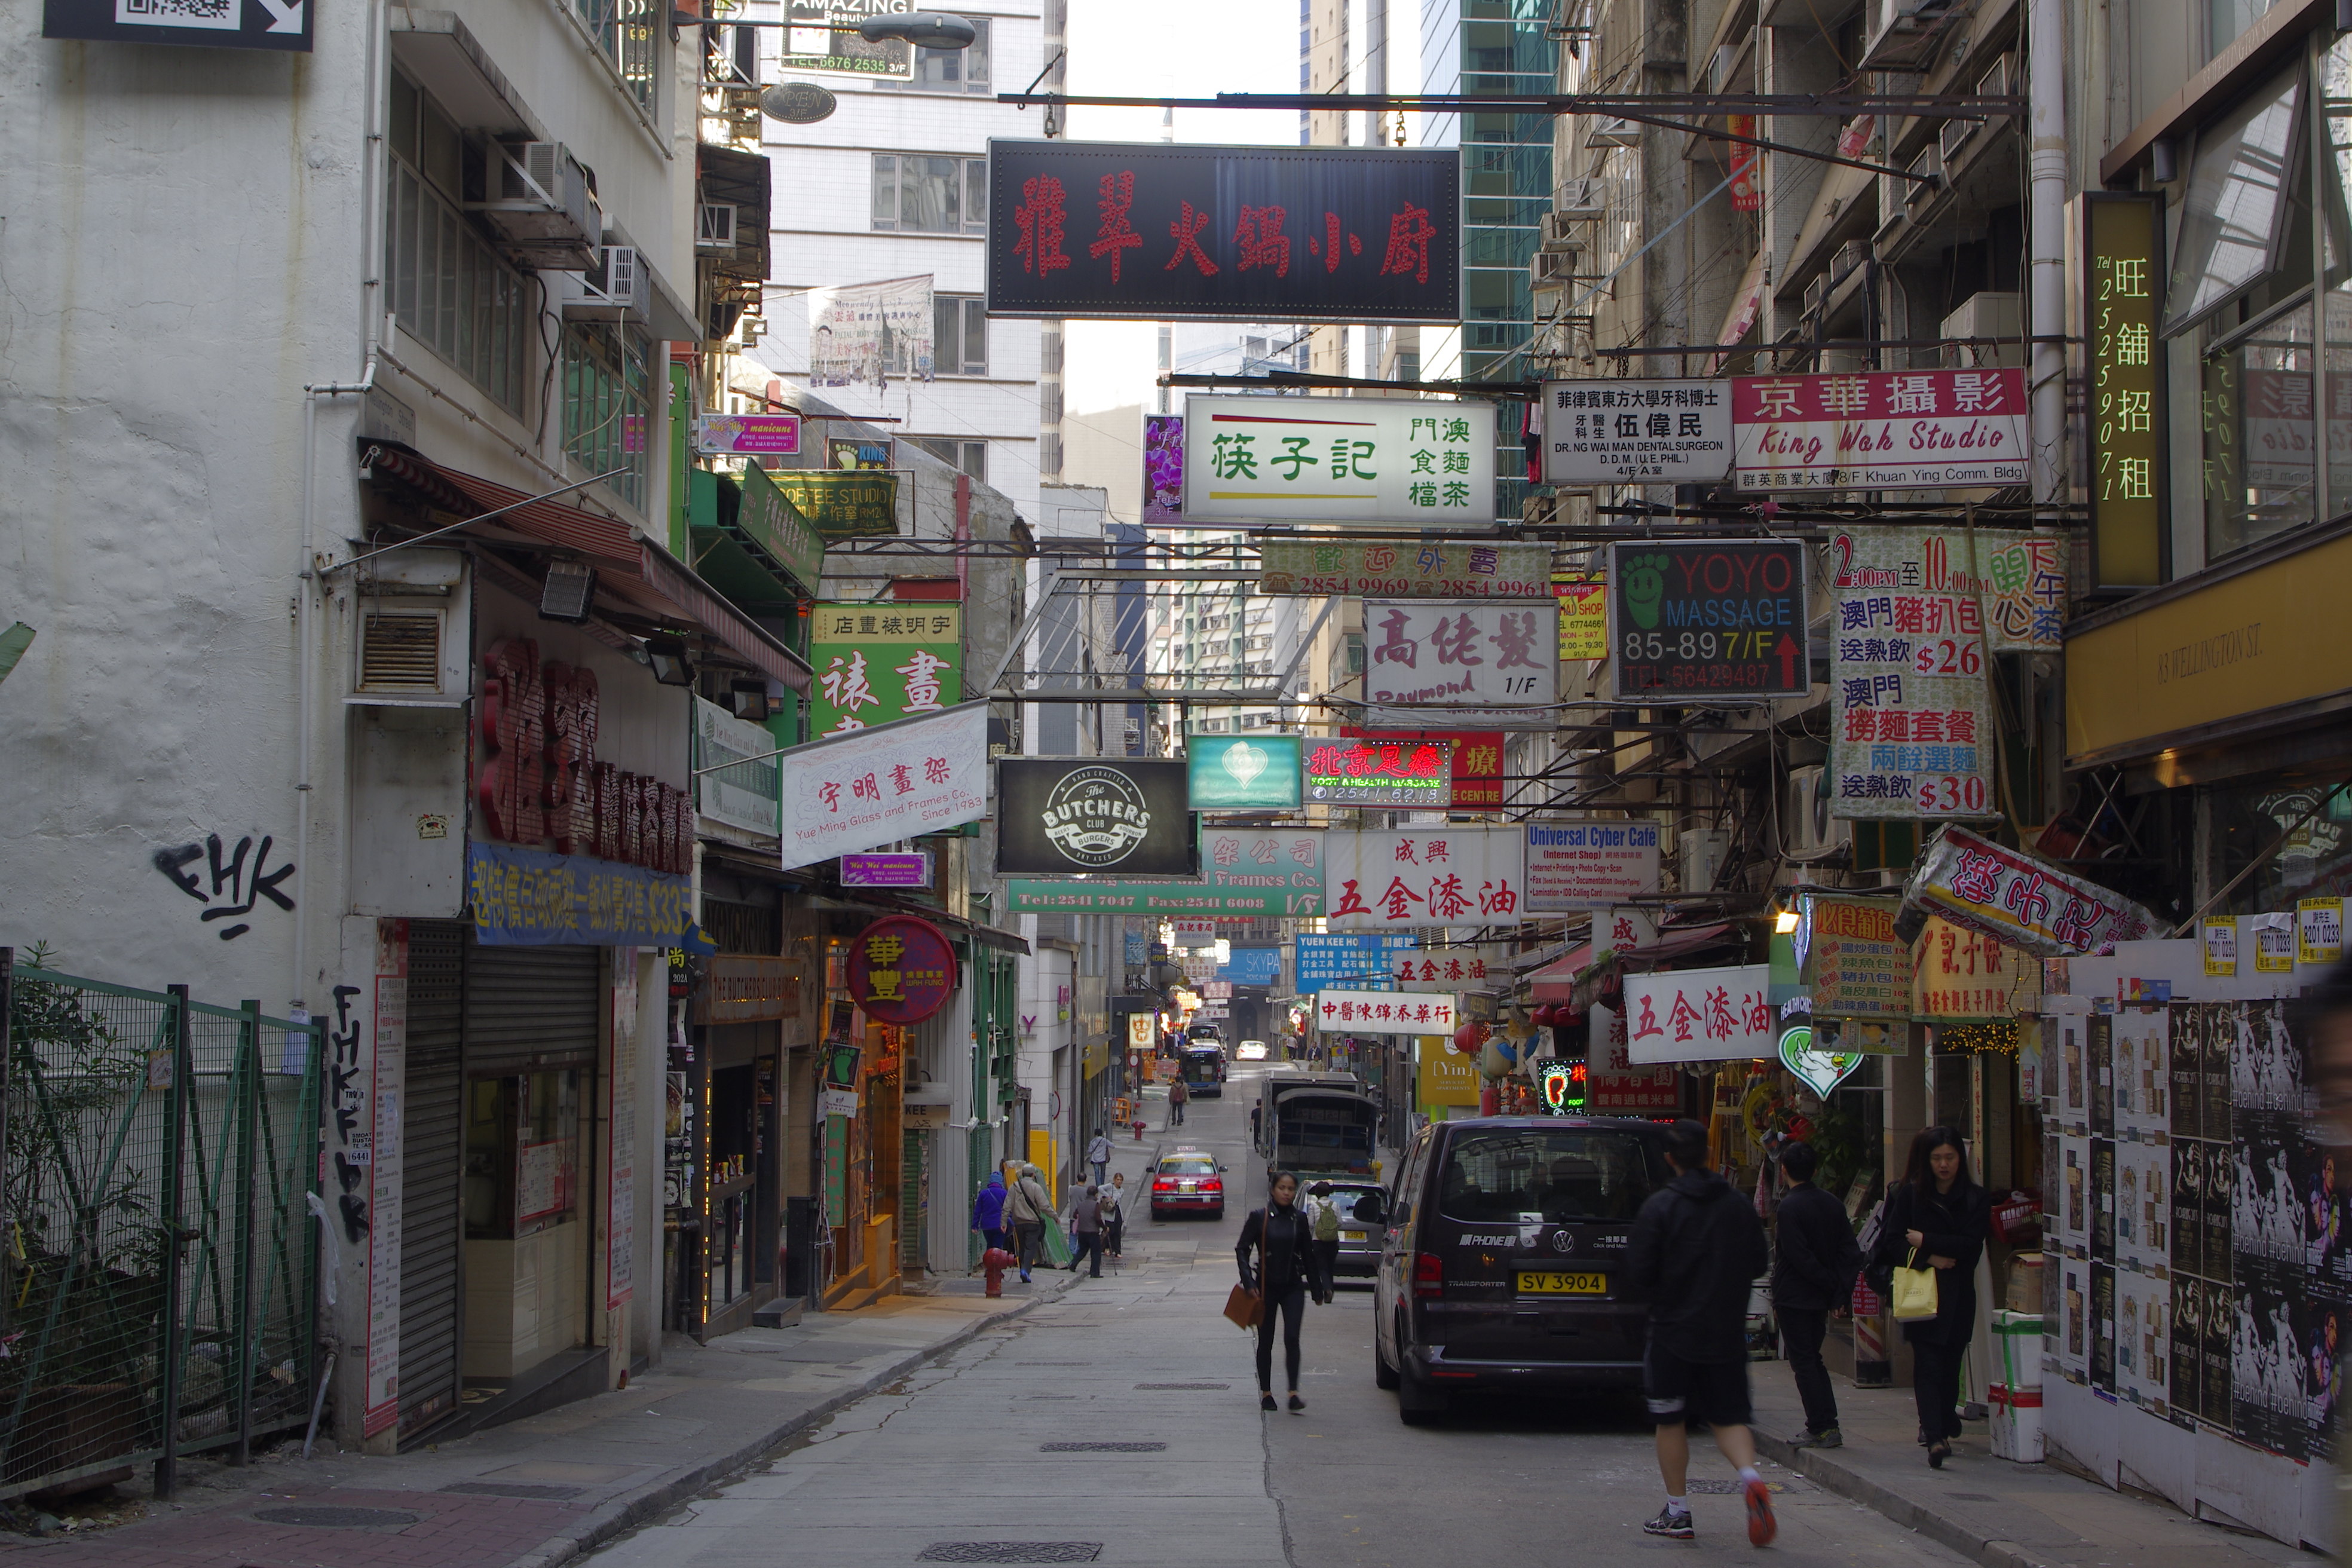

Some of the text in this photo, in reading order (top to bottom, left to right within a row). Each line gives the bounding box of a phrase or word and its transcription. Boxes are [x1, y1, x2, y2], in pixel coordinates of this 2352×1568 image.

[855, 59, 906, 72] 2535 3/F
[790, 109, 807, 117] 3/F
[2097, 256, 2111, 269] Tel
[2115, 257, 2152, 500] 旺舖招租
[1557, 389, 1718, 409] 菲律賓東方大學牙科博士
[1751, 373, 2005, 418] 京華攝影
[1614, 413, 1702, 438] 伍偉民
[1555, 441, 1723, 452] DR. NG WAI MAN DENTAL SURGEON
[1758, 419, 2004, 464] King Wah Studio
[859, 446, 886, 461] KING
[1211, 433, 1377, 481] 筷子記
[1839, 467, 2023, 483] 8/F Khuan Ying Comm. Bldg
[839, 488, 887, 504] STUDIO
[1312, 544, 1500, 577] 歡迎外賣
[1833, 533, 1919, 589] 2:00PM 至
[1676, 553, 1791, 593] YOYO
[1298, 577, 1546, 597] 2854 9969 2854 9961
[1579, 603, 1603, 615] SHOP
[1667, 598, 1791, 627] MASSAGE
[1625, 631, 1774, 660] 85-89 7/F
[1840, 638, 1982, 675] 送熱飲 $26
[2157, 653, 2170, 685] 83
[2172, 628, 2243, 679] WELLINGTON
[1506, 677, 1537, 696] 1/F
[1843, 675, 1902, 709] 澳門
[1845, 709, 1976, 743] 撈麵套餐
[1310, 744, 1443, 778] 北京足療
[818, 757, 951, 813] 宇明畫架
[1072, 770, 1125, 785] HAND CRAFTED
[1085, 785, 1105, 798] The
[1461, 789, 1499, 802] CENTRE
[1842, 775, 1985, 811] 送熱飲 $30
[795, 789, 970, 840] Yue Ming Glass and Frames Co.
[922, 797, 982, 821] Since 1983
[1042, 799, 1151, 828] BUTCHERS
[1086, 819, 1105, 828] CLUB
[1054, 825, 1142, 846] BEERS BURGERS BOURBON
[1530, 826, 1656, 849] Universal Cyber Café
[1076, 852, 1111, 862] DRY AGED
[1396, 838, 1450, 866] 成興
[1544, 850, 1577, 859] (Internet
[1579, 850, 1601, 860] Shop)
[1579, 863, 1592, 872] Photo
[1594, 863, 1606, 874] Copy
[1610, 864, 1622, 872] Scan
[1291, 871, 1320, 887] Co.
[1058, 895, 1092, 906] 2541
[1099, 896, 1135, 907] 7047
[1187, 897, 1221, 908] 2541
[1227, 898, 1264, 909] 6008
[1331, 874, 1516, 920] 五金漆油
[1573, 889, 1589, 898] Calling
[1591, 889, 1602, 897] Card
[1300, 937, 1344, 947] YUEN KEE
[2261, 935, 2291, 953] 8201 0233
[2304, 924, 2339, 944] 8201 0233
[865, 934, 906, 1002] 華豐
[1399, 958, 1487, 982] 五金漆油
[1841, 957, 1892, 969] 辣魚包
[673, 973, 688, 983] 202A
[906, 979, 944, 987] WAH FUNG
[714, 976, 726, 1002] THE
[728, 976, 760, 1001] BUTCHERS
[1321, 1000, 1452, 1024] 中醫陳錦添藥行
[1633, 985, 1771, 1043] 五金漆油
[1568, 1098, 1584, 1106] FOOT
[1597, 1093, 1675, 1106] 雲南過橋米線
[905, 1104, 927, 1116] KEE
[351, 1153, 369, 1161] 6441
[1523, 1275, 1601, 1290] SV 3904
